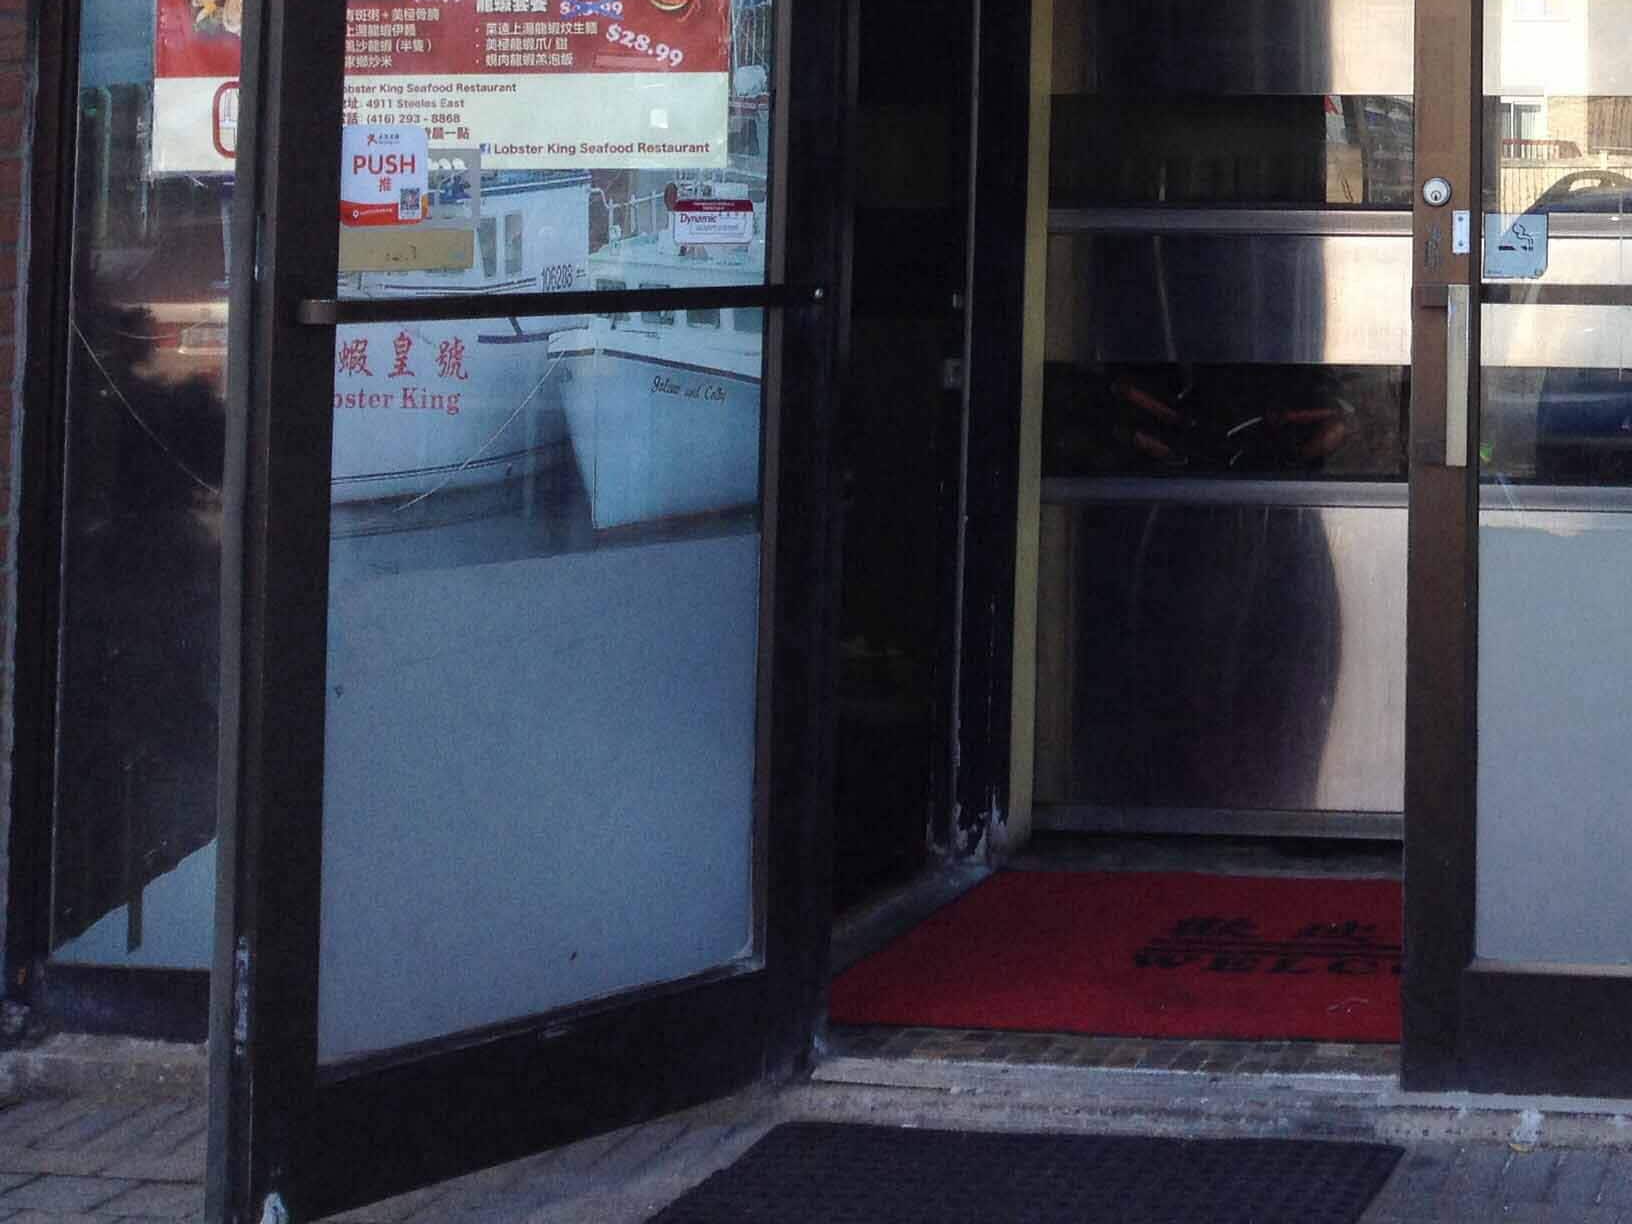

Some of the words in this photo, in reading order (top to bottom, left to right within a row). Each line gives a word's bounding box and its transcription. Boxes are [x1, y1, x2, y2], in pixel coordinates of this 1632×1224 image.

[605, 23, 684, 67] $28.99
[379, 83, 404, 95] King
[406, 82, 453, 94] Seafood
[456, 82, 518, 93] Restaurant
[365, 98, 393, 109] 4911
[439, 98, 465, 109] East
[366, 113, 395, 125] (416)
[399, 113, 421, 124] 293
[431, 113, 461, 124] 8868
[493, 143, 544, 154] Lobster
[547, 142, 577, 156] King
[579, 142, 634, 154] Seafood
[637, 141, 711, 153] Restaurant
[353, 154, 417, 175] PUSH
[378, 177, 392, 192] 推
[337, 331, 469, 380] 蝦皇號
[400, 386, 461, 416] King
